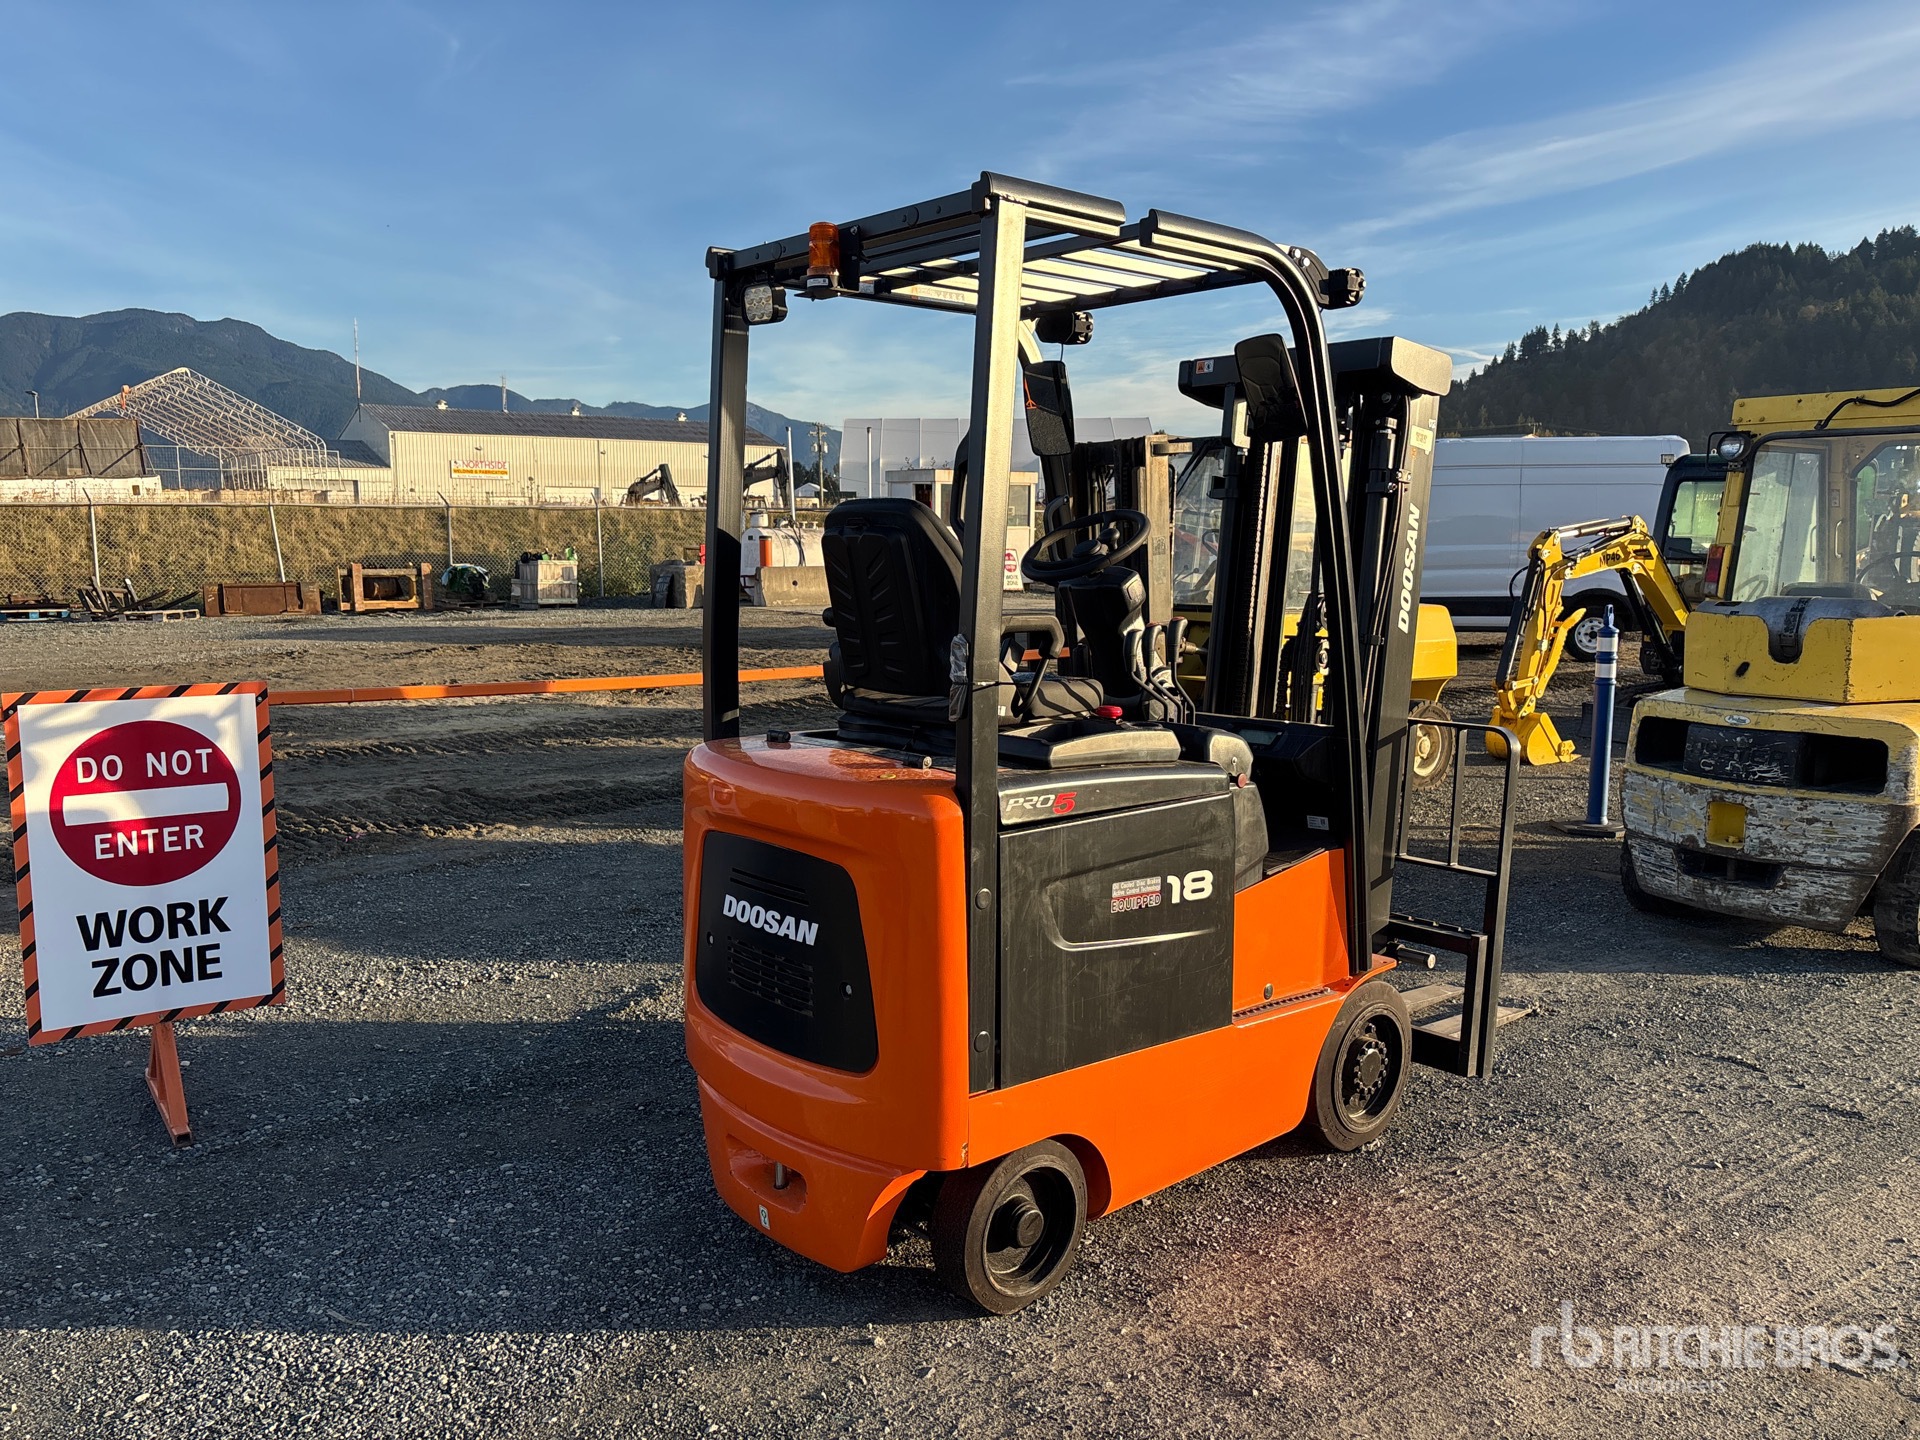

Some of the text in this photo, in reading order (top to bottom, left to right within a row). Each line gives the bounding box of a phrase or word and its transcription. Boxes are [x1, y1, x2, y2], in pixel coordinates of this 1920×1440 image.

[462, 460, 507, 469] NORTHSIDE
[1398, 503, 1420, 634] DOOSAN
[76, 748, 213, 784] DO NOT
[94, 824, 205, 860] ENTER
[1111, 893, 1161, 913] EQUIPPED
[1166, 869, 1214, 904] 18
[76, 896, 231, 952] WORK
[723, 894, 819, 946] DOOSAN
[91, 943, 223, 998] ZONE
